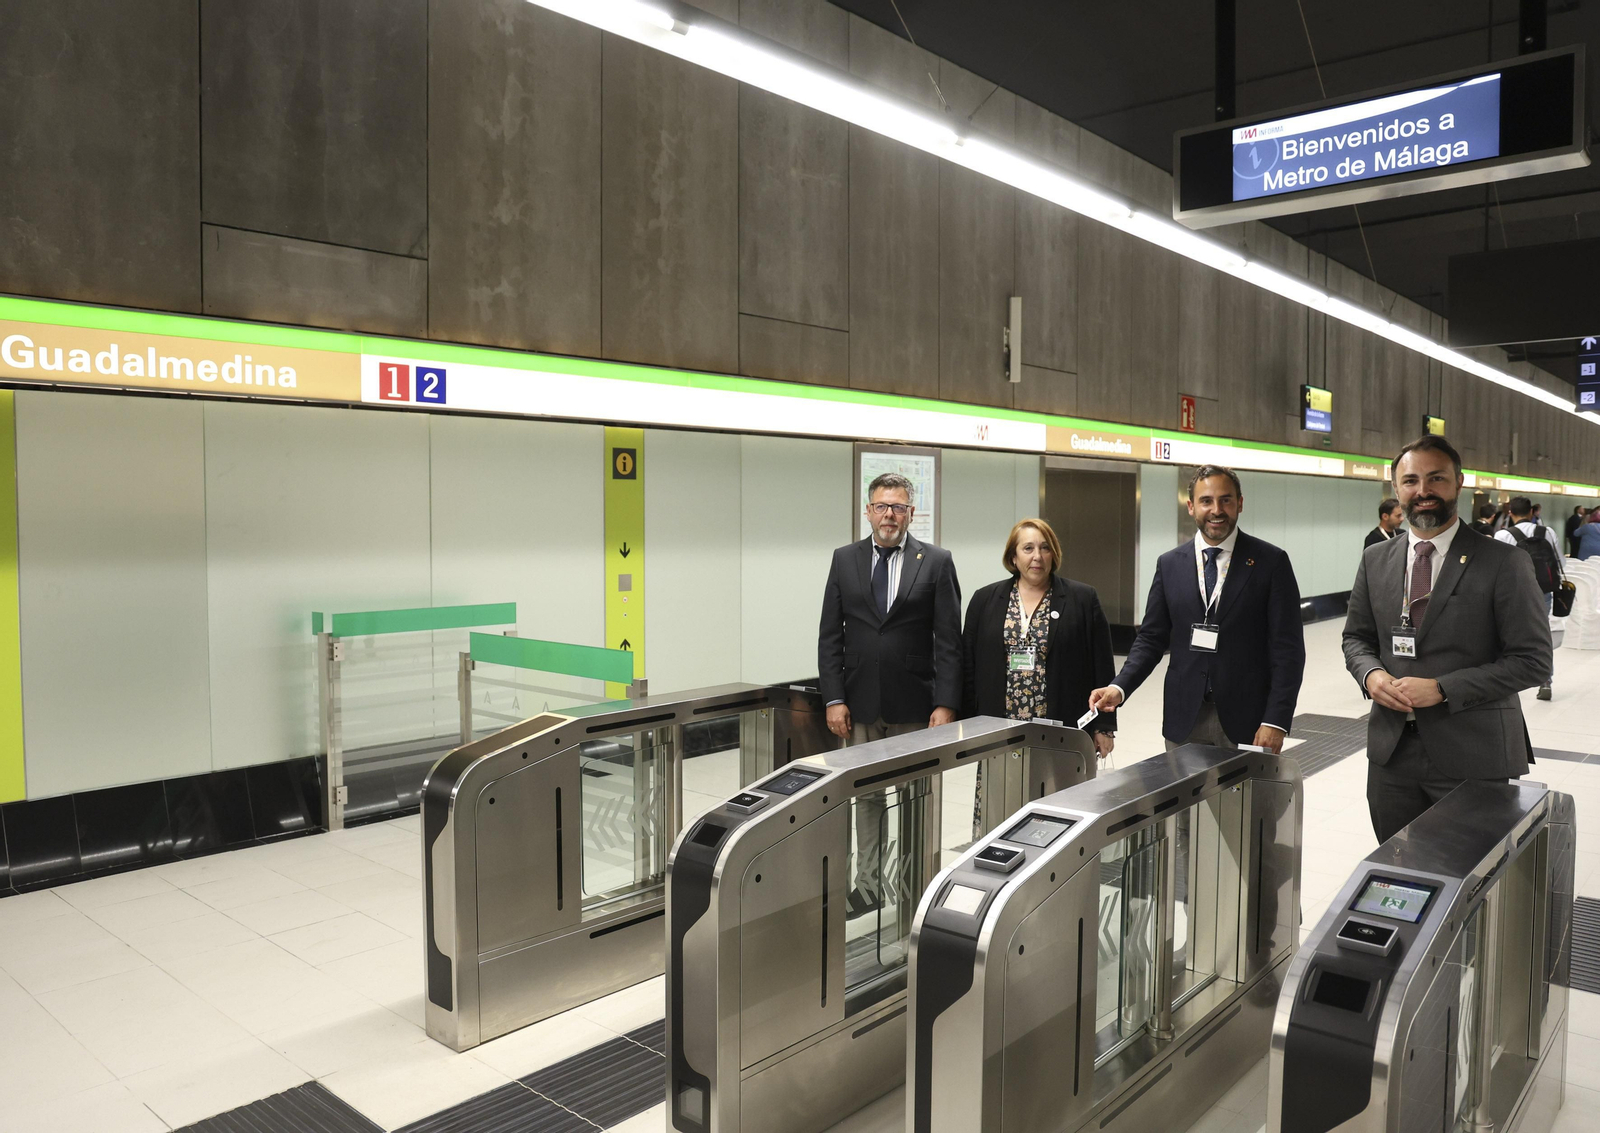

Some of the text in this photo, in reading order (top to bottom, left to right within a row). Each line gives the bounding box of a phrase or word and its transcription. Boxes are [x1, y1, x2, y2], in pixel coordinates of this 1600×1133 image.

[1258, 125, 1284, 136] INFORMA
[1282, 113, 1455, 160] Bienvenidos a
[1263, 139, 1469, 191] Metro de Málaga
[1, 334, 440, 398] Guadalmedina 1 2
[1070, 433, 1132, 455] Guadalmedina
